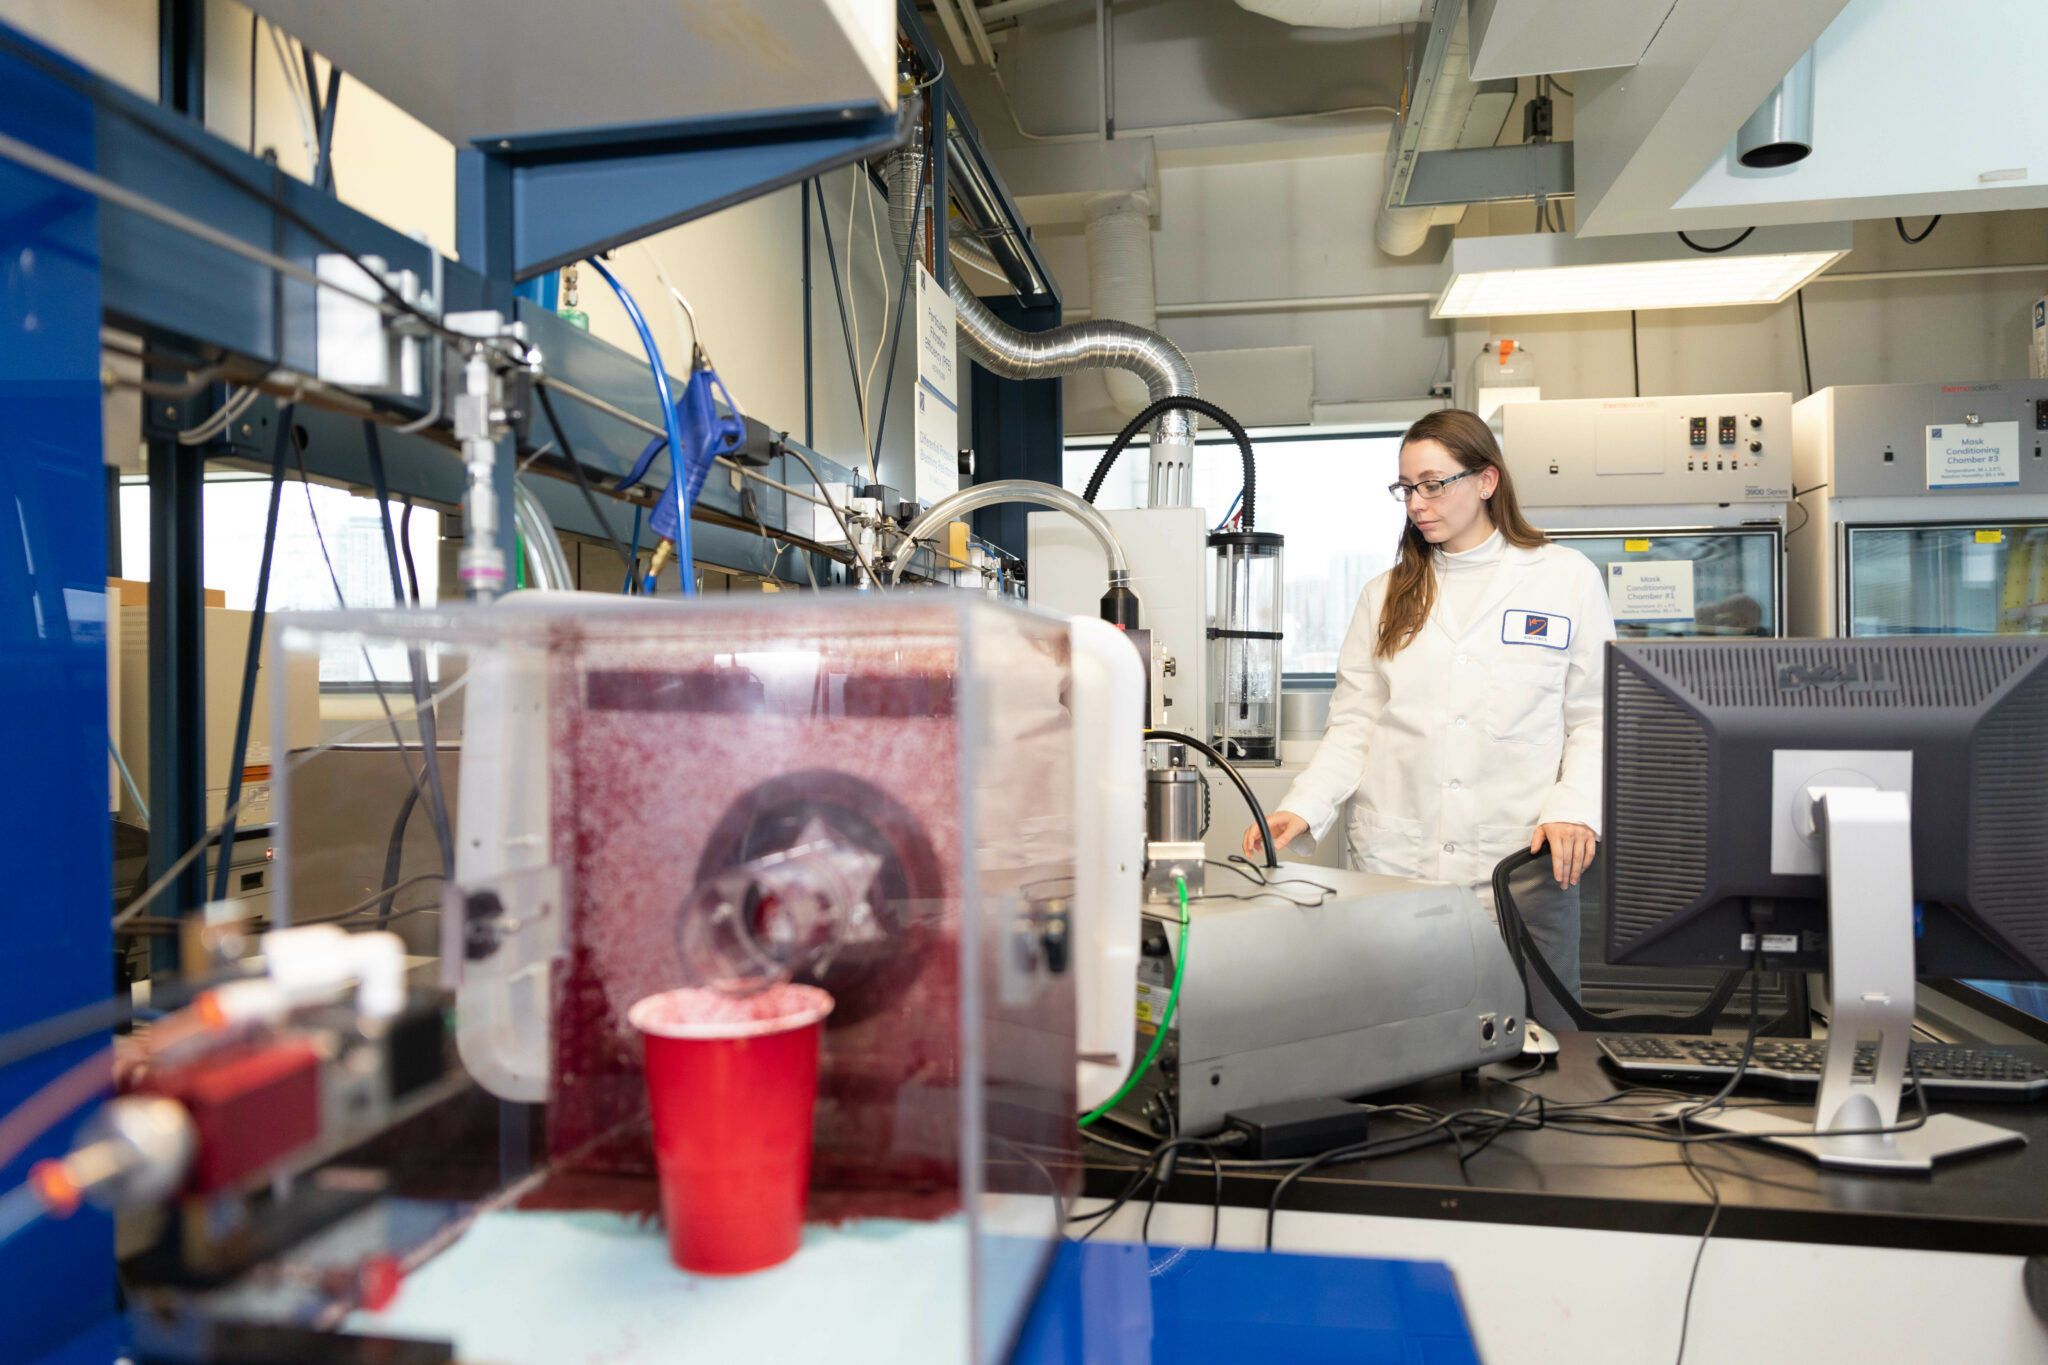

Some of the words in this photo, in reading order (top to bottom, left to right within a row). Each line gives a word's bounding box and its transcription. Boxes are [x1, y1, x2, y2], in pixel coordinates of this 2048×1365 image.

[1961, 438, 1984, 446] Mask
[1946, 447, 2000, 455] Conditioning
[1947, 456, 1985, 465] Chamber
[1988, 455, 1999, 463] #3
[1626, 584, 1676, 592] Conditioning
[1627, 592, 1662, 600] Chamber
